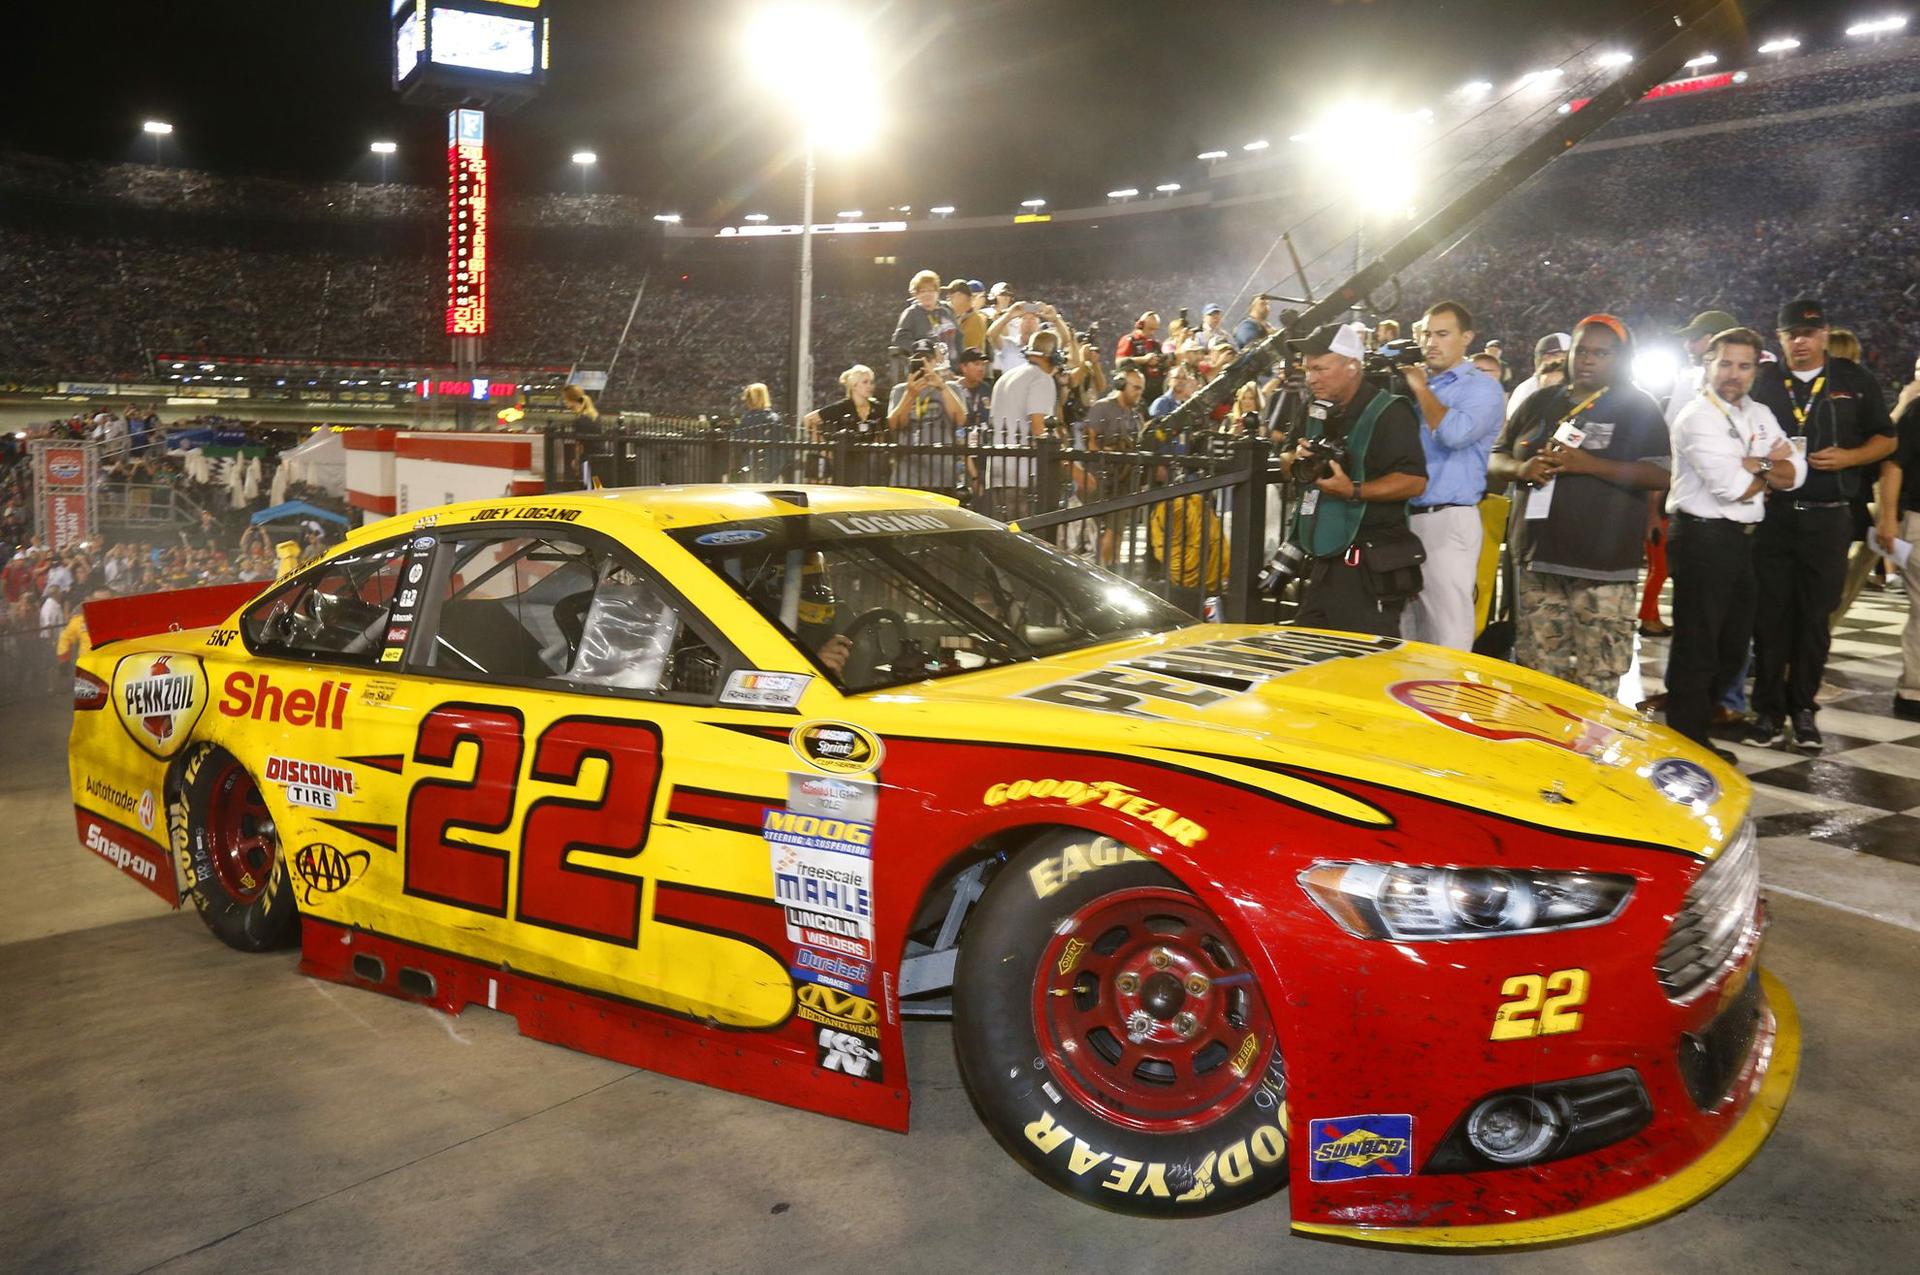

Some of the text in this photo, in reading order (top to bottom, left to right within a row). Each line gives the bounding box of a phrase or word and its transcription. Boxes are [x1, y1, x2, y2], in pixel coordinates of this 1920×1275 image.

[470, 507, 582, 521] JOEY LOGANO
[828, 515, 949, 535] LOGANO
[207, 630, 239, 647] SKF
[125, 675, 194, 716] PENNZOIL
[219, 671, 351, 730] Shell
[816, 740, 853, 755] Sprint
[265, 757, 353, 795] DISCOUNT
[86, 776, 137, 814] Autotrader
[293, 787, 332, 807] TIRE
[403, 702, 662, 948] 22
[765, 811, 874, 845] MOOG
[983, 779, 1209, 848] GOODYEAR
[86, 824, 157, 881] Snap-on
[764, 831, 867, 856] STEERING & SUSPENSION
[299, 844, 349, 891] AAA
[799, 862, 863, 886] freescale
[775, 872, 869, 916] MAHLE
[789, 909, 860, 938] LINCOLN
[805, 930, 866, 955] WELDERS
[798, 948, 867, 982] Duralast
[817, 974, 852, 990] BRAKES
[798, 1005, 879, 1038] MECHANIX WEAR
[1490, 968, 1590, 1042] 22
[1238, 1040, 1253, 1067] AERO
[1317, 1139, 1402, 1160] SUNOCO
